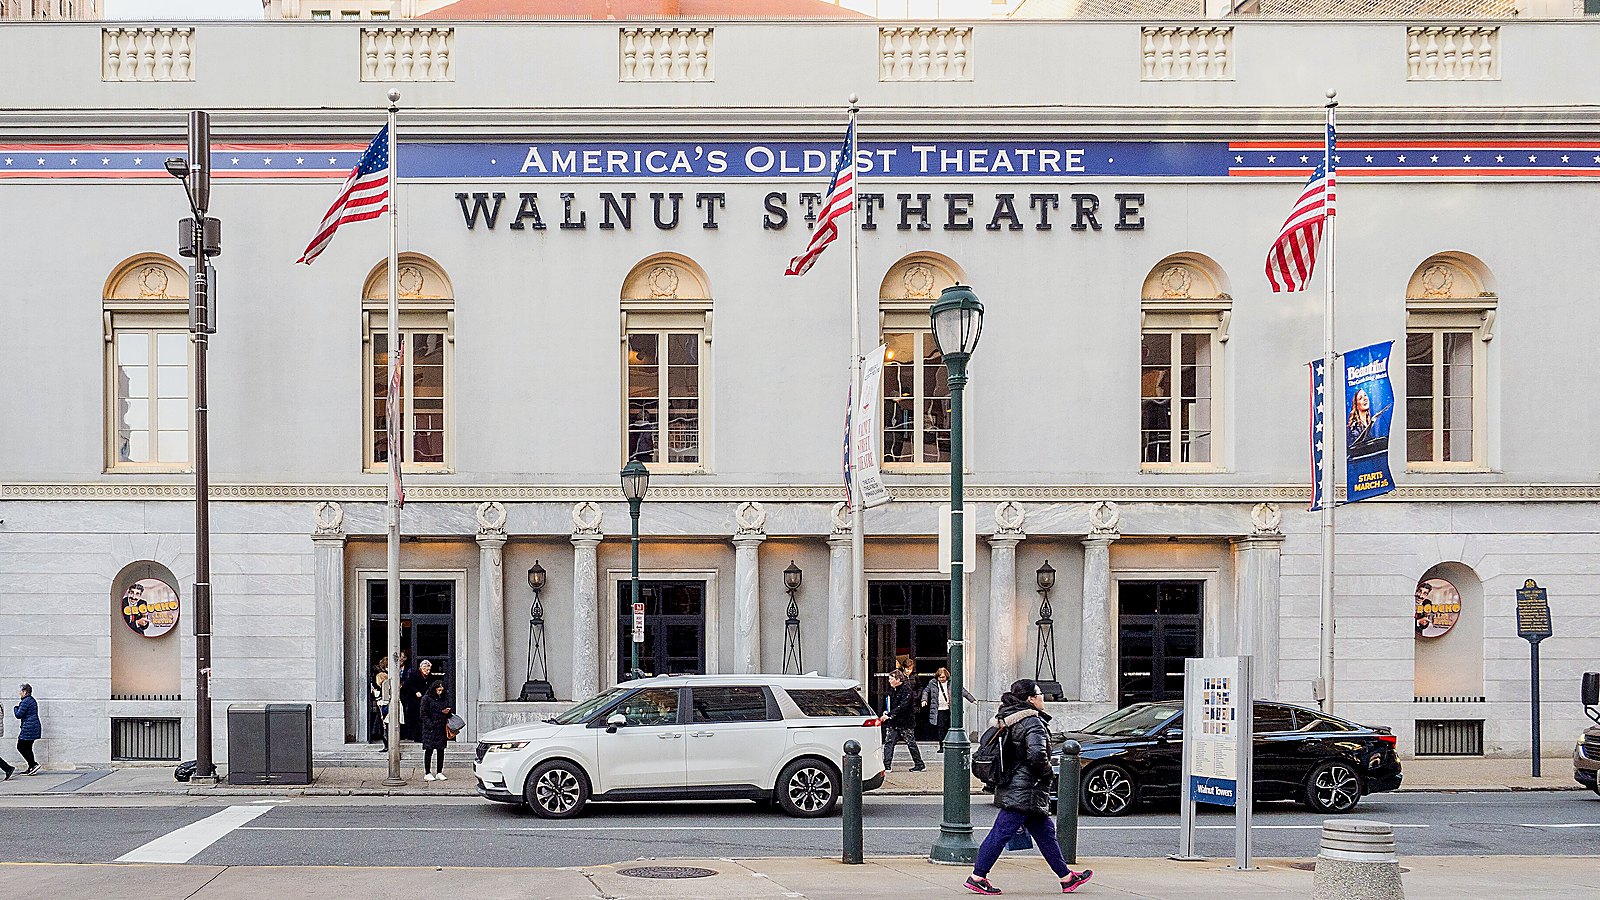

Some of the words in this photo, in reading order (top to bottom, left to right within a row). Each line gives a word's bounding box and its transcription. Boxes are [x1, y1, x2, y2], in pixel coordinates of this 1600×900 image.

[520, 146, 728, 173] AMERICA'S
[912, 144, 1085, 172] THEATRE
[455, 192, 725, 230] WALNUT
[857, 193, 1145, 230] THEATRE
[1347, 357, 1388, 380] Beautiful
[1358, 471, 1383, 483] STARTS
[1354, 480, 1381, 492] MARCH
[1380, 478, 1389, 487] 26
[1416, 603, 1461, 614] ROUCHO
[1197, 784, 1215, 796] Walnut
[1215, 786, 1233, 797] Towers
